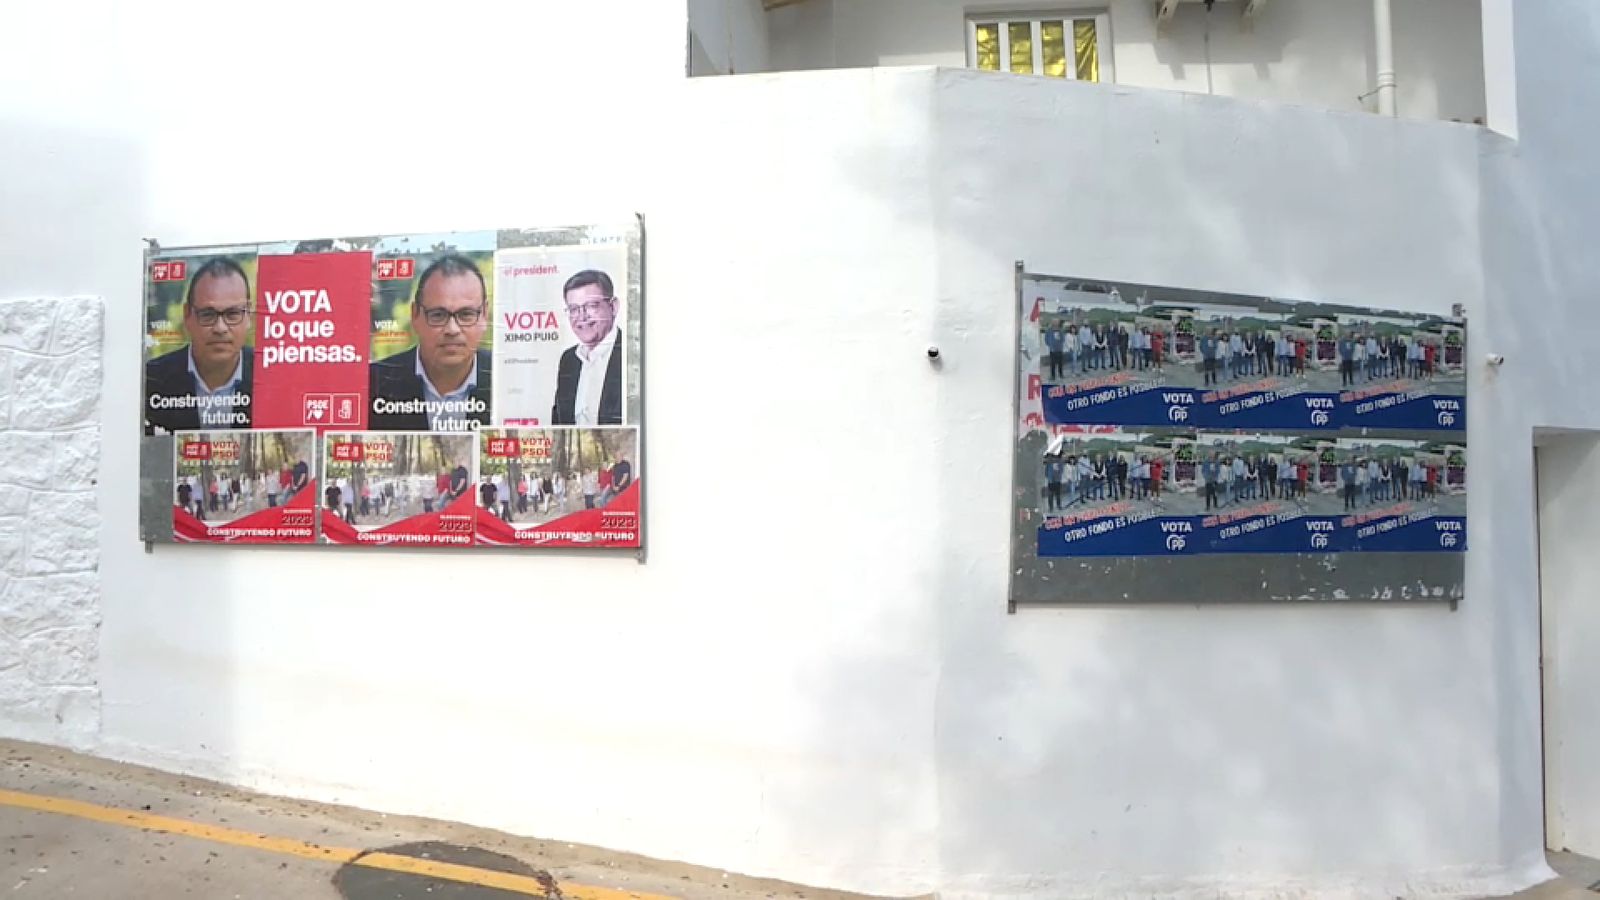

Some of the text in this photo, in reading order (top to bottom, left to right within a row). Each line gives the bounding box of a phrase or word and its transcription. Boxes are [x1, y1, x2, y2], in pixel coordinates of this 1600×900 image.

[513, 265, 559, 278] president.
[264, 289, 332, 314] VOTA
[151, 320, 172, 329] VOTA
[374, 320, 398, 329] VOTA
[504, 312, 559, 329] VOTA
[264, 317, 335, 342] lo que
[504, 331, 559, 343] XIMO PUIG
[263, 341, 362, 368] piensas.
[150, 391, 251, 413] Construyendo
[306, 399, 329, 409] PSOE
[1067, 396, 1089, 411] OTRO
[1090, 389, 1116, 404] FONDO
[1162, 392, 1194, 404] VOTA
[1305, 398, 1334, 409] VOTA
[373, 396, 486, 416] Construyendo
[1220, 402, 1240, 415] OTRO
[1241, 395, 1264, 409] FONDO
[1356, 402, 1374, 414] OTRO
[1375, 396, 1396, 409] FONDO
[1433, 400, 1459, 410] VOTA
[202, 410, 250, 425] futuro.
[521, 438, 552, 446] VOTA
[366, 453, 393, 461] PSOE
[522, 448, 552, 456] PSOE
[282, 514, 313, 525] 2023
[602, 516, 636, 528] 2023
[207, 527, 312, 537] CONSTRUYENDO FUTURO
[439, 520, 472, 532] 2023
[1065, 527, 1087, 543] OTRO
[1088, 520, 1114, 536] FONDO
[1160, 521, 1193, 533] VOTA
[1220, 525, 1240, 539] OTRO
[1241, 518, 1265, 534] FONDO
[1306, 521, 1334, 531] VOTA
[1357, 525, 1375, 539] OTRO
[1376, 518, 1397, 533] FONDO
[1435, 521, 1462, 531] VOTA
[357, 533, 470, 544] CONSTRUYENDO FUTURO
[515, 531, 592, 541] CONSTRUYENDO
